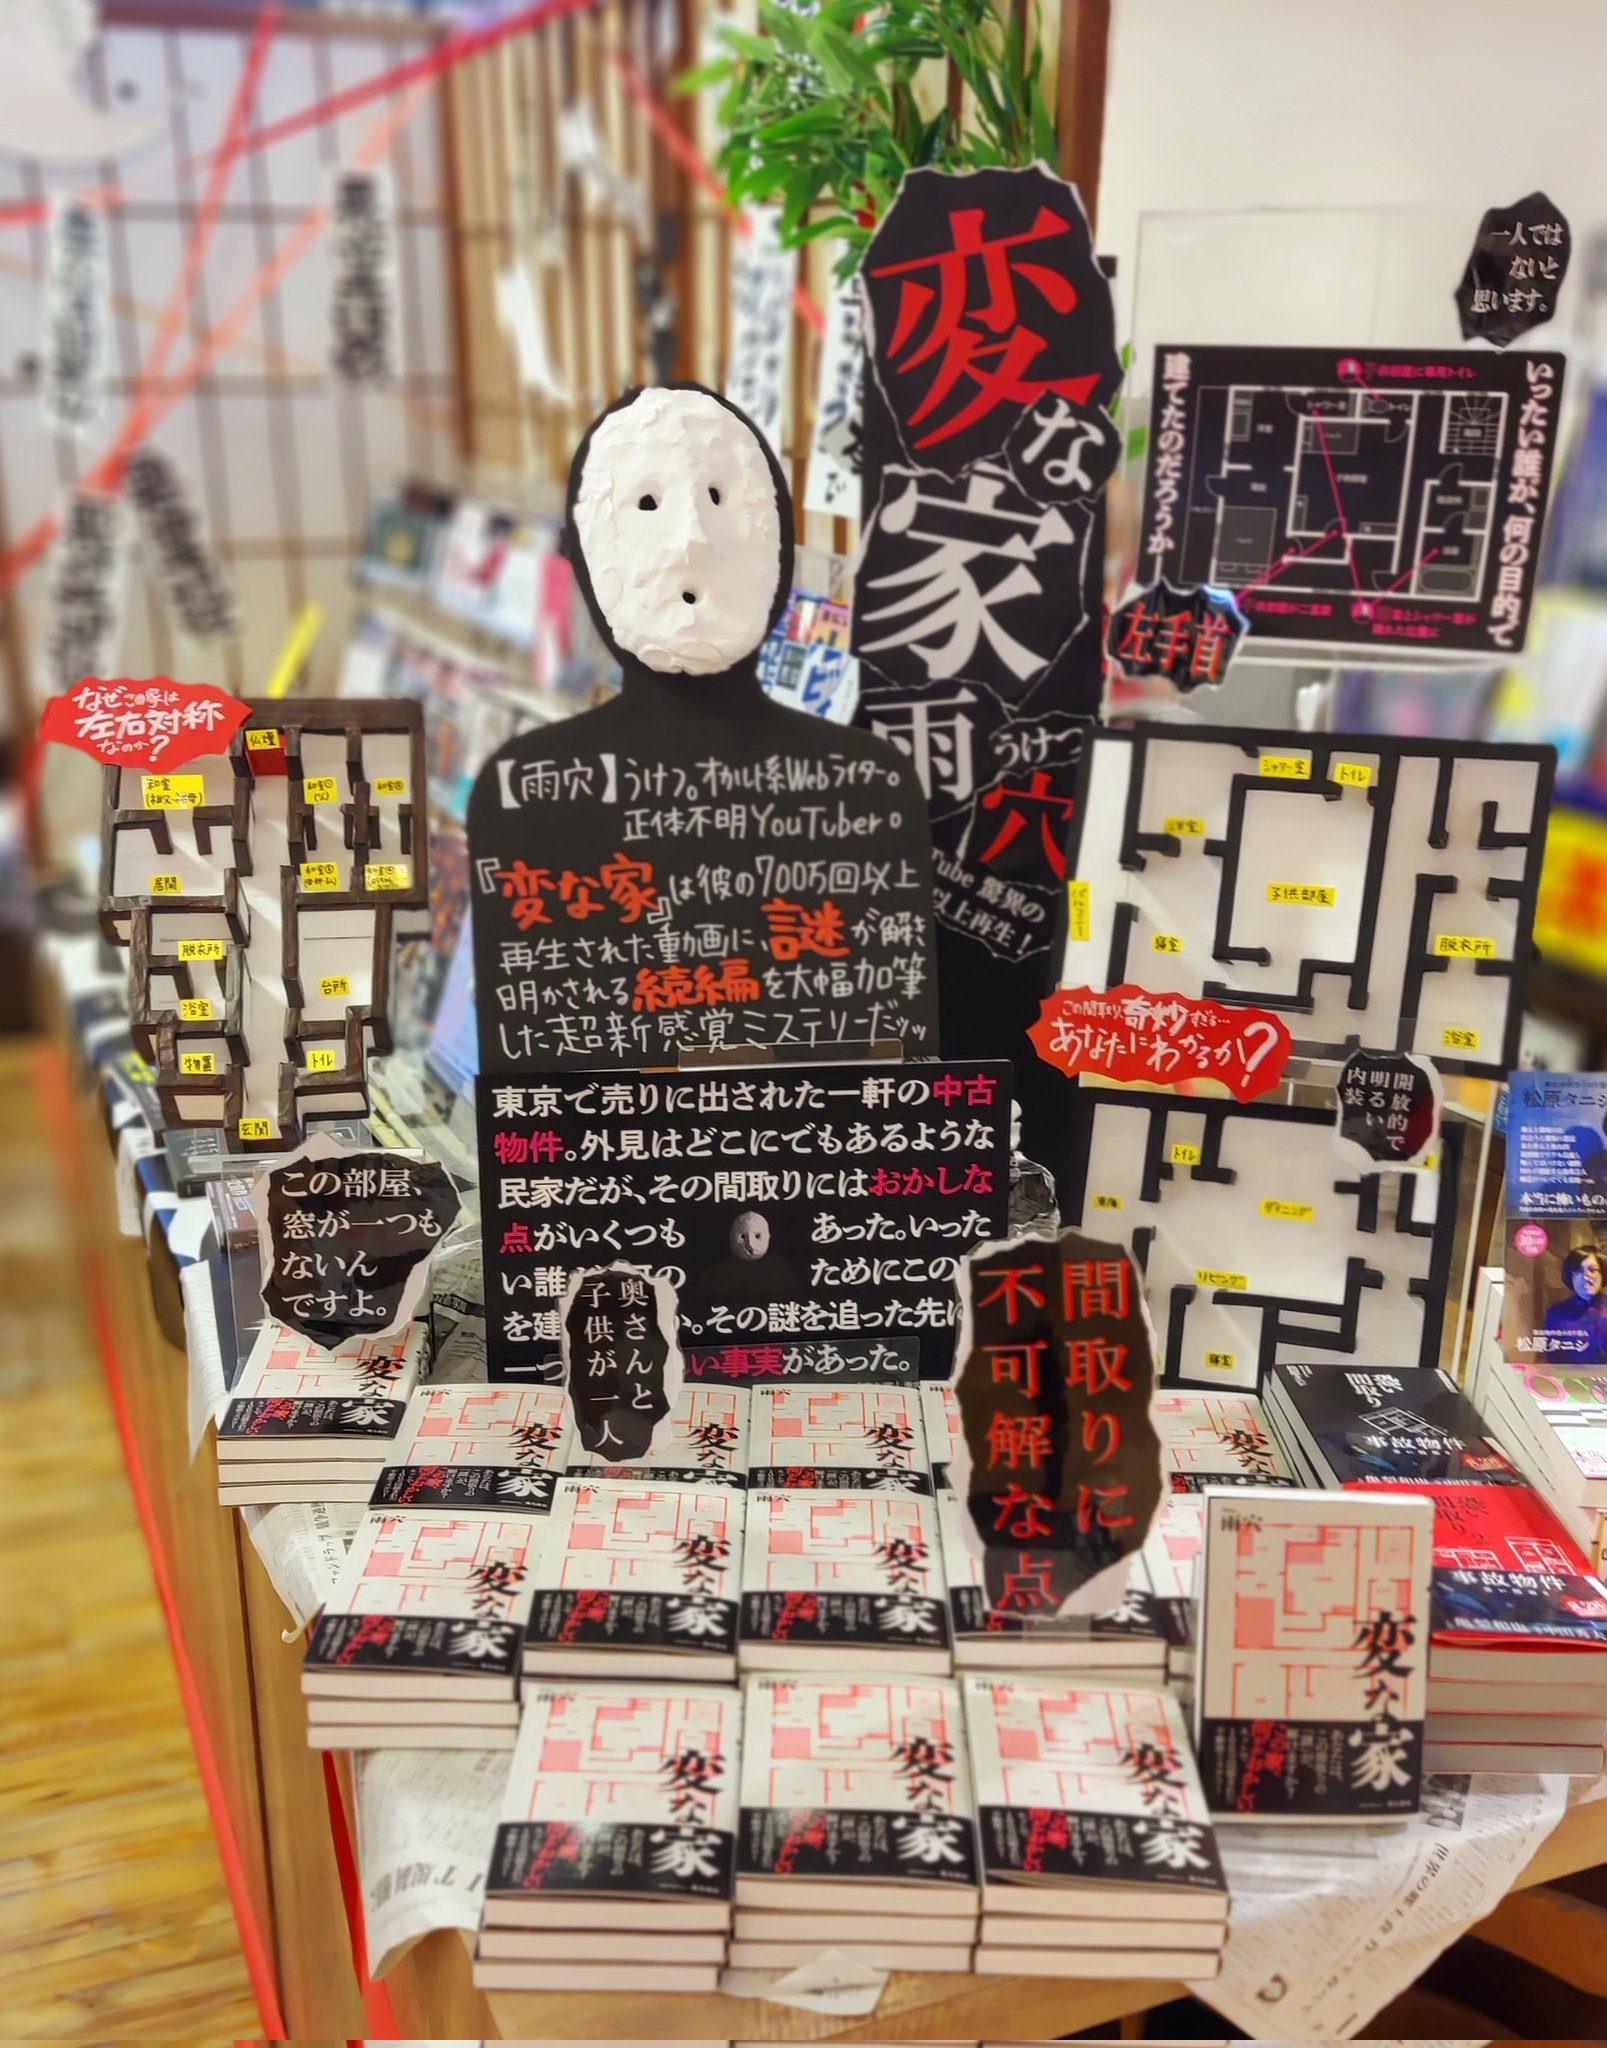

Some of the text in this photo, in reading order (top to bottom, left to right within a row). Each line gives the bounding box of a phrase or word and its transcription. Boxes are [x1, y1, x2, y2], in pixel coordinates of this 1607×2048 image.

[1490, 222, 1564, 246] 一人では
[1509, 255, 1560, 280] ないと
[1470, 288, 1548, 313] 思います。
[1117, 601, 1231, 682] 左手首
[75, 700, 225, 740] 左右対称
[154, 877, 177, 891] 居間
[1270, 886, 1329, 904] 子供部屋
[182, 944, 220, 957] 脱衣所
[322, 980, 347, 994] 台所
[496, 953, 927, 1013] 明かされる続編を大幅加筆
[183, 1002, 209, 1017] 浴室
[185, 1055, 212, 1071] 物置
[311, 1053, 333, 1068] トイレ
[492, 1073, 997, 1119] 東京で売りに出された一軒の中古
[1344, 1066, 1367, 1106] 内装
[1368, 1070, 1390, 1126] 明るい
[241, 1122, 269, 1136] 玄関
[1386, 1072, 1415, 1151] 開放的で
[492, 1119, 995, 1164] 物件。外見はどこにでもあるような
[281, 1168, 423, 1198] この部屋、
[497, 1163, 995, 1211] 民家だが、その間取りにはおかしな
[282, 1208, 442, 1240] 窓が一つも
[499, 1209, 992, 1254] 点がいくつも あった。いった
[281, 1250, 378, 1279] ないん
[500, 1264, 686, 1297] い誰の
[281, 1289, 388, 1318] ですよ。
[581, 1281, 625, 1447] 子供が一人
[618, 1278, 653, 1410] 奥さんと
[339, 1355, 407, 1426] 変な家
[1062, 1257, 1134, 1534] 間取りに
[977, 1263, 1061, 1609] 不可解な点
[496, 1423, 564, 1498] 変な家
[666, 1535, 732, 1636] 変な家
[874, 1538, 939, 1633] 変な家
[1450, 1570, 1567, 1591] 事故物件
[449, 1562, 529, 1658] 変な家
[1348, 1611, 1418, 1791] 変な家
[650, 1750, 727, 1877] 変な家
[890, 1737, 966, 1863] 変な家
[1119, 1742, 1212, 1869] 変な家
